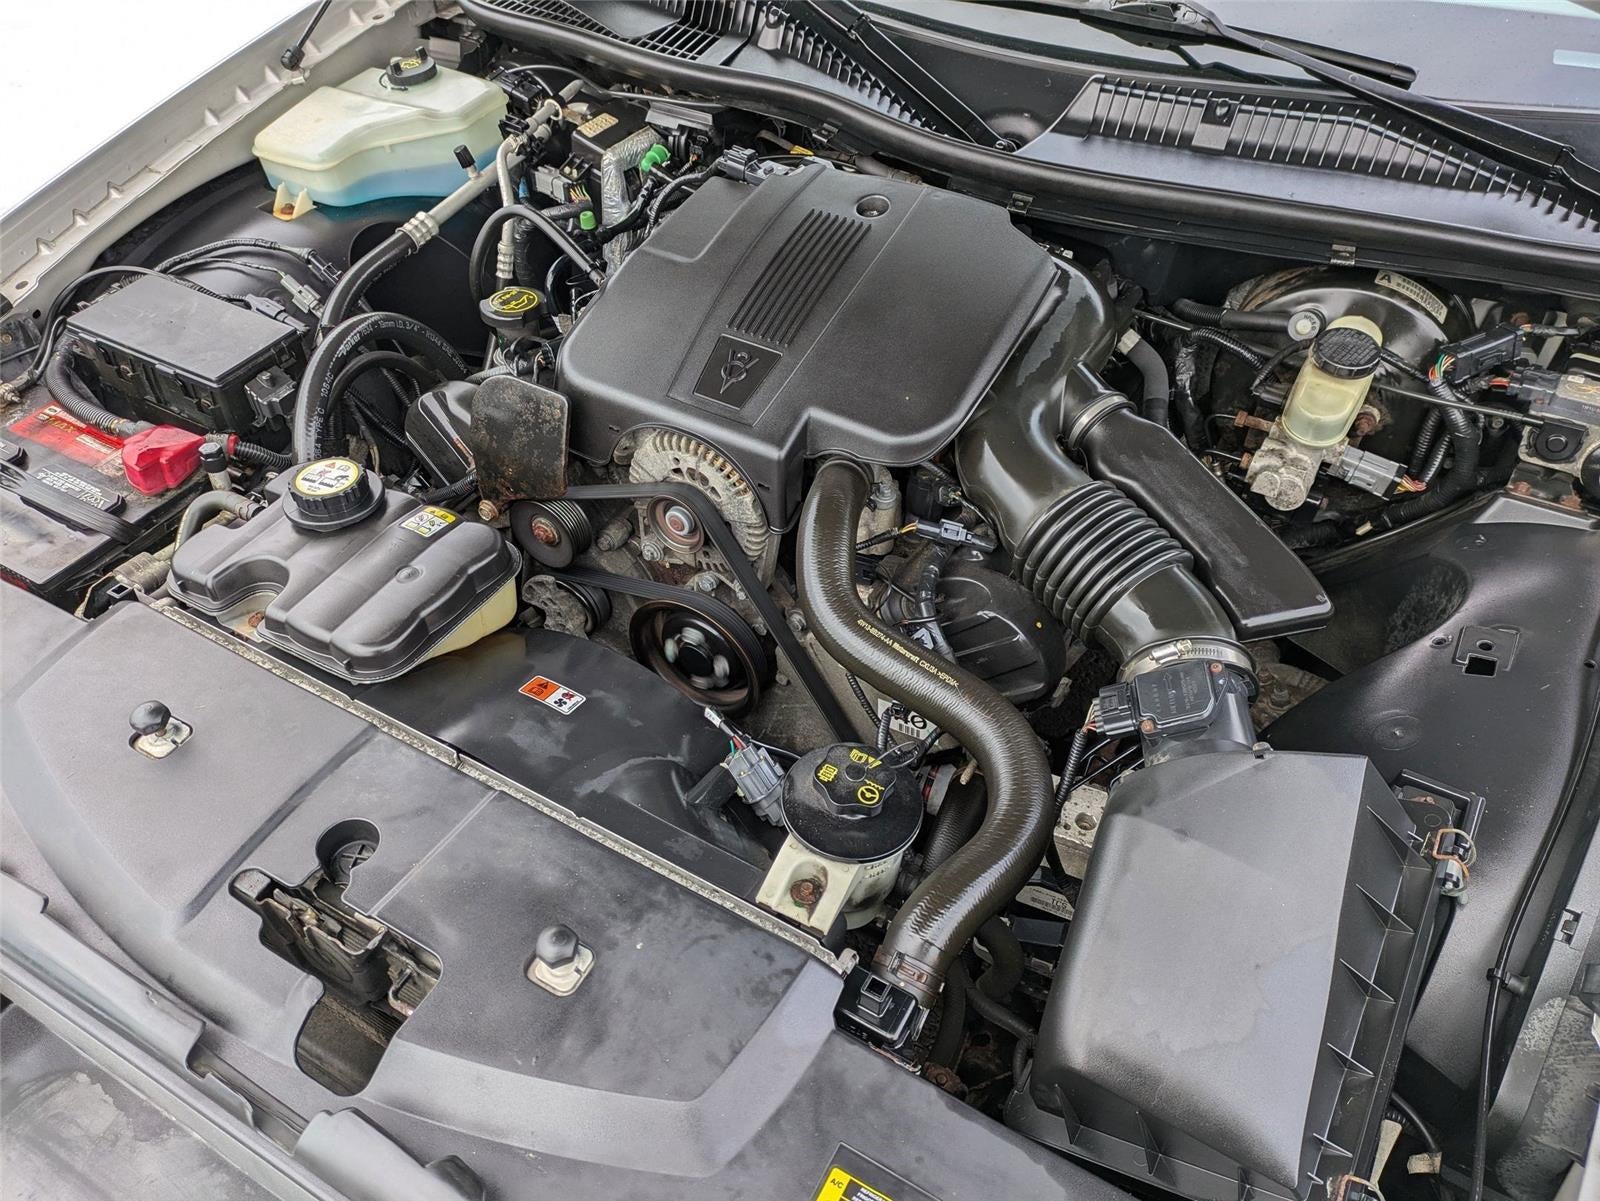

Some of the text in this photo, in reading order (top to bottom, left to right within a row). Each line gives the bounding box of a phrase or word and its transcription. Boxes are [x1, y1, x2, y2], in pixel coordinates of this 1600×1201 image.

[1379, 274, 1392, 284] A
[317, 407, 325, 415] C
[315, 417, 324, 439] TYPE
[892, 642, 920, 664] Motorcraft
[830, 1178, 844, 1189] A/C
